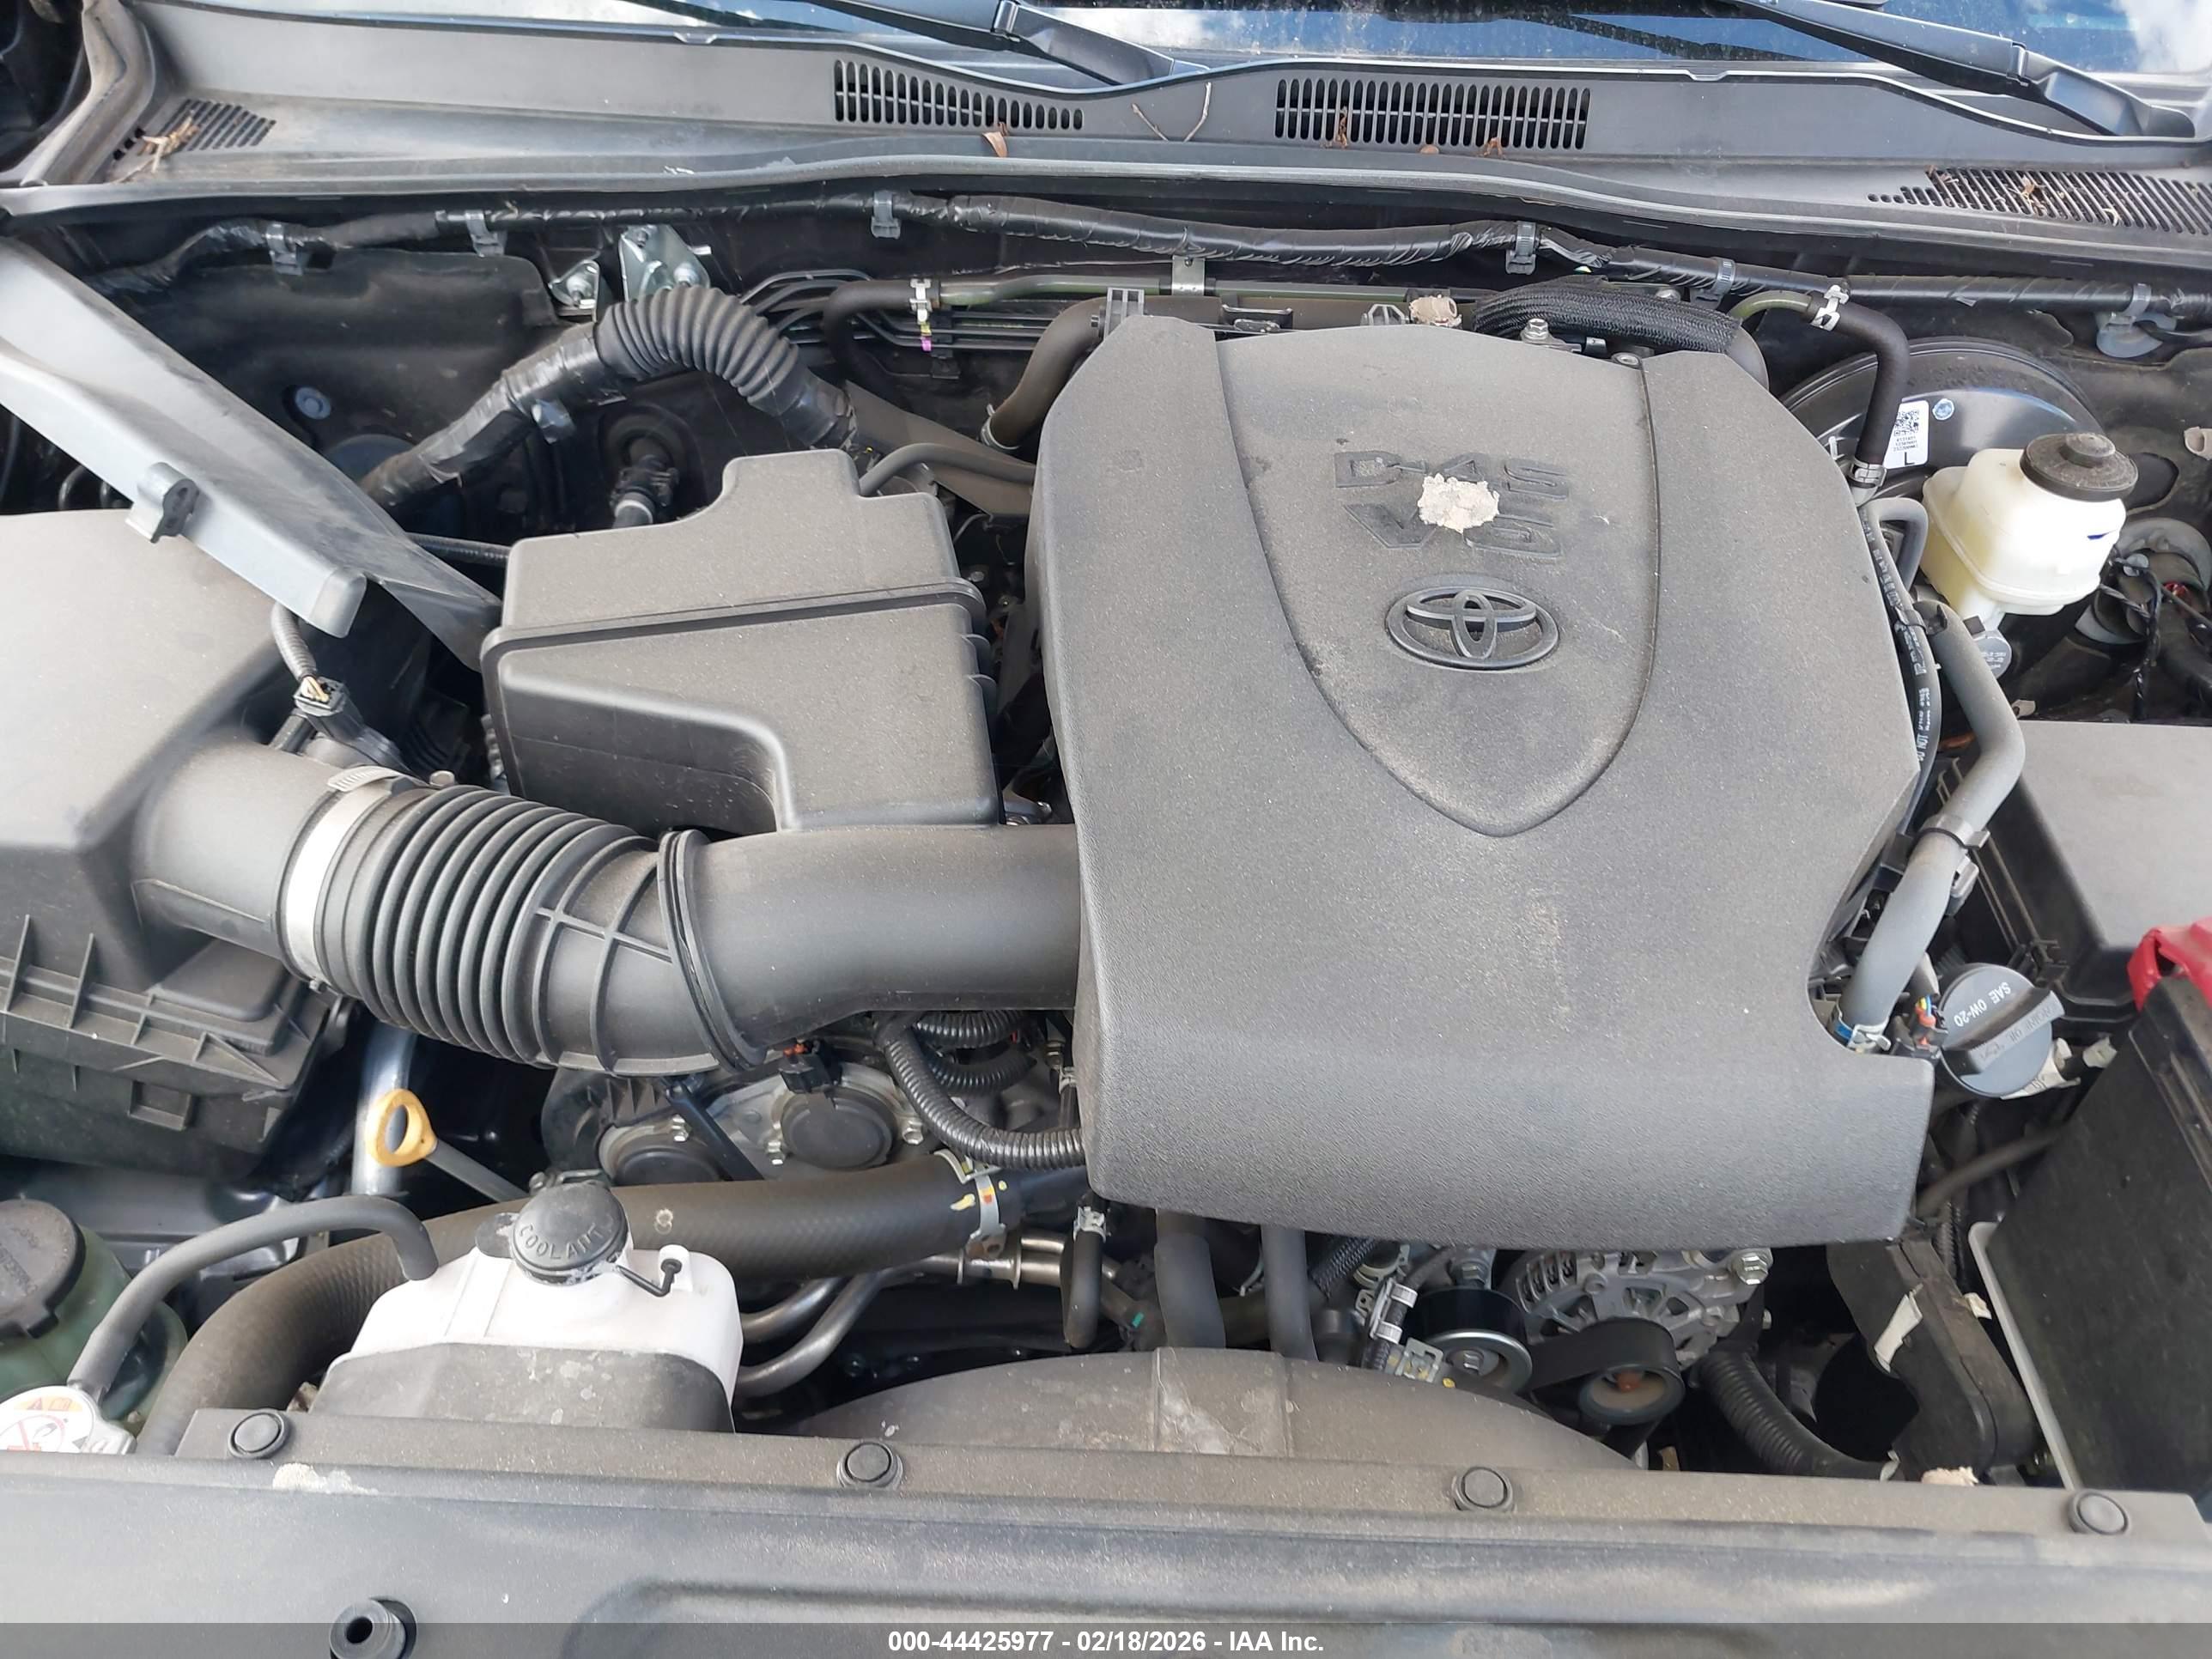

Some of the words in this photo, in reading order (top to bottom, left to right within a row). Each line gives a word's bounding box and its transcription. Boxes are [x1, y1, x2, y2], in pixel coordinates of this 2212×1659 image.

[1904, 452, 1916, 465] L
[1988, 981, 2011, 1005] SAE
[1954, 999, 1987, 1027] 0W-20
[520, 1222, 603, 1260] COOLANT
